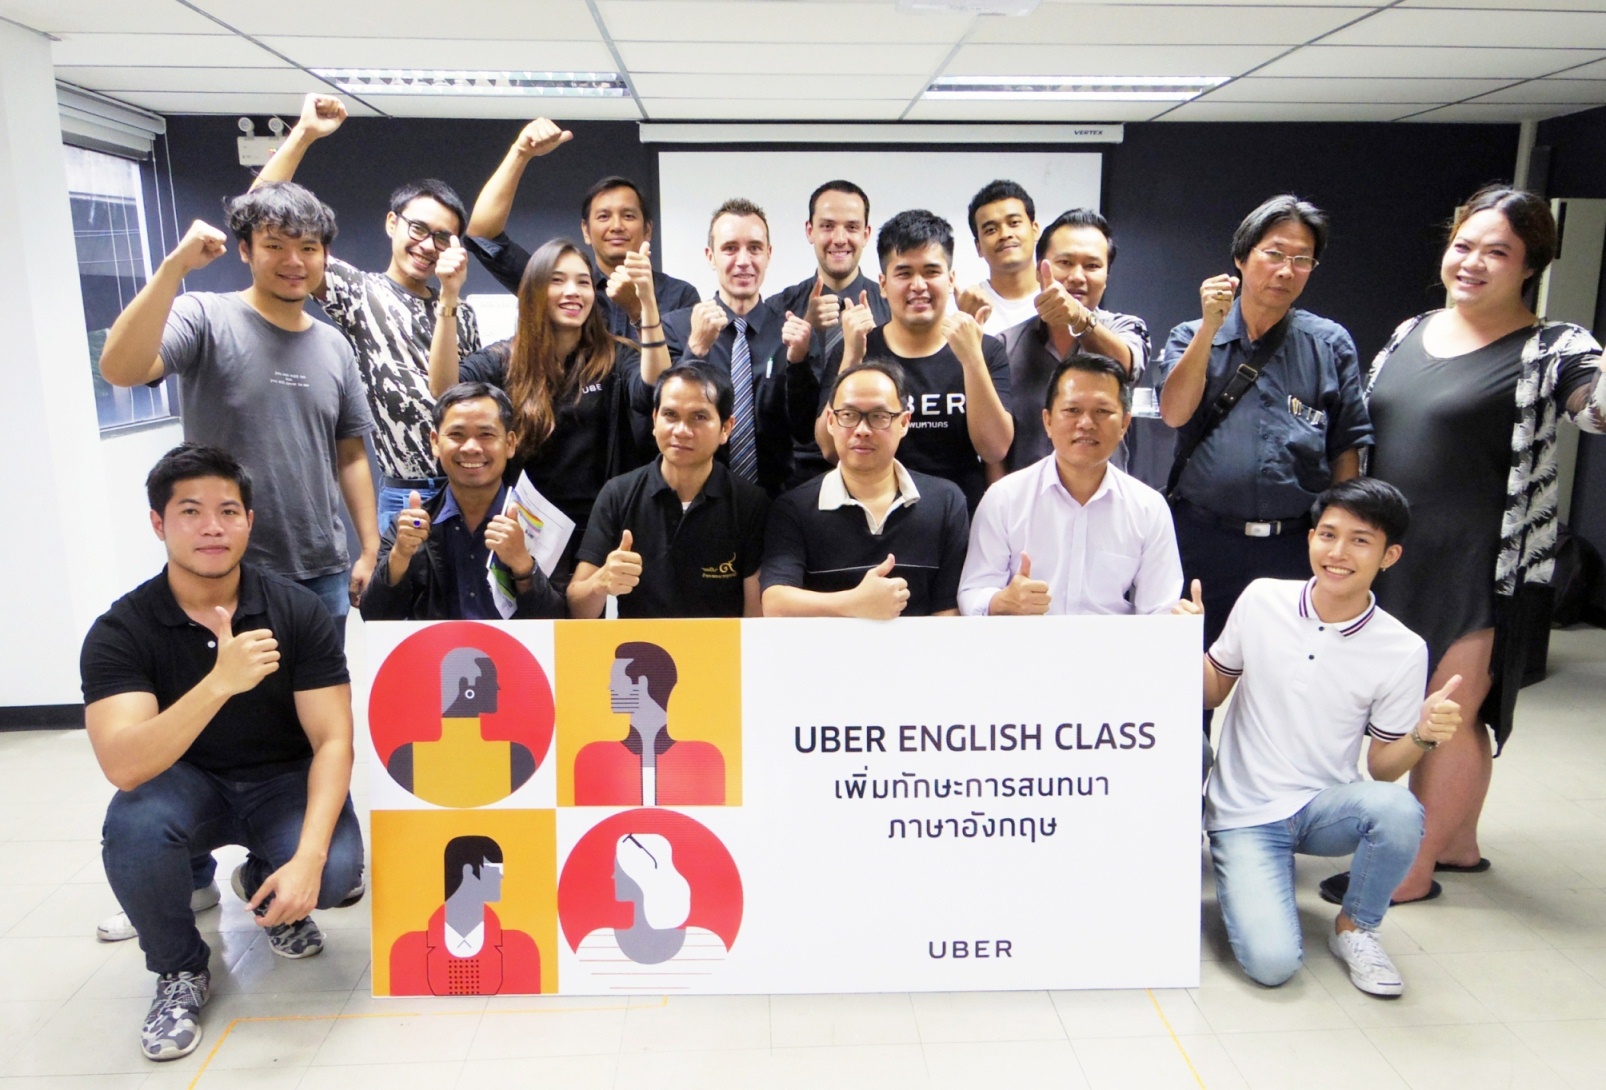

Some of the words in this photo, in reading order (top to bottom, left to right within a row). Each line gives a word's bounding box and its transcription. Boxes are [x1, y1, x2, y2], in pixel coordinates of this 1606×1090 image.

[582, 383, 602, 394] UBE
[795, 725, 887, 753] UBER
[899, 723, 1041, 752] ENGLISH
[1054, 721, 1156, 750] CLASS
[835, 765, 1109, 799] เพิ่มทักษะการสนทนา
[888, 811, 1057, 843] ภาษาอังกฤษ
[928, 939, 1012, 959] UBER
